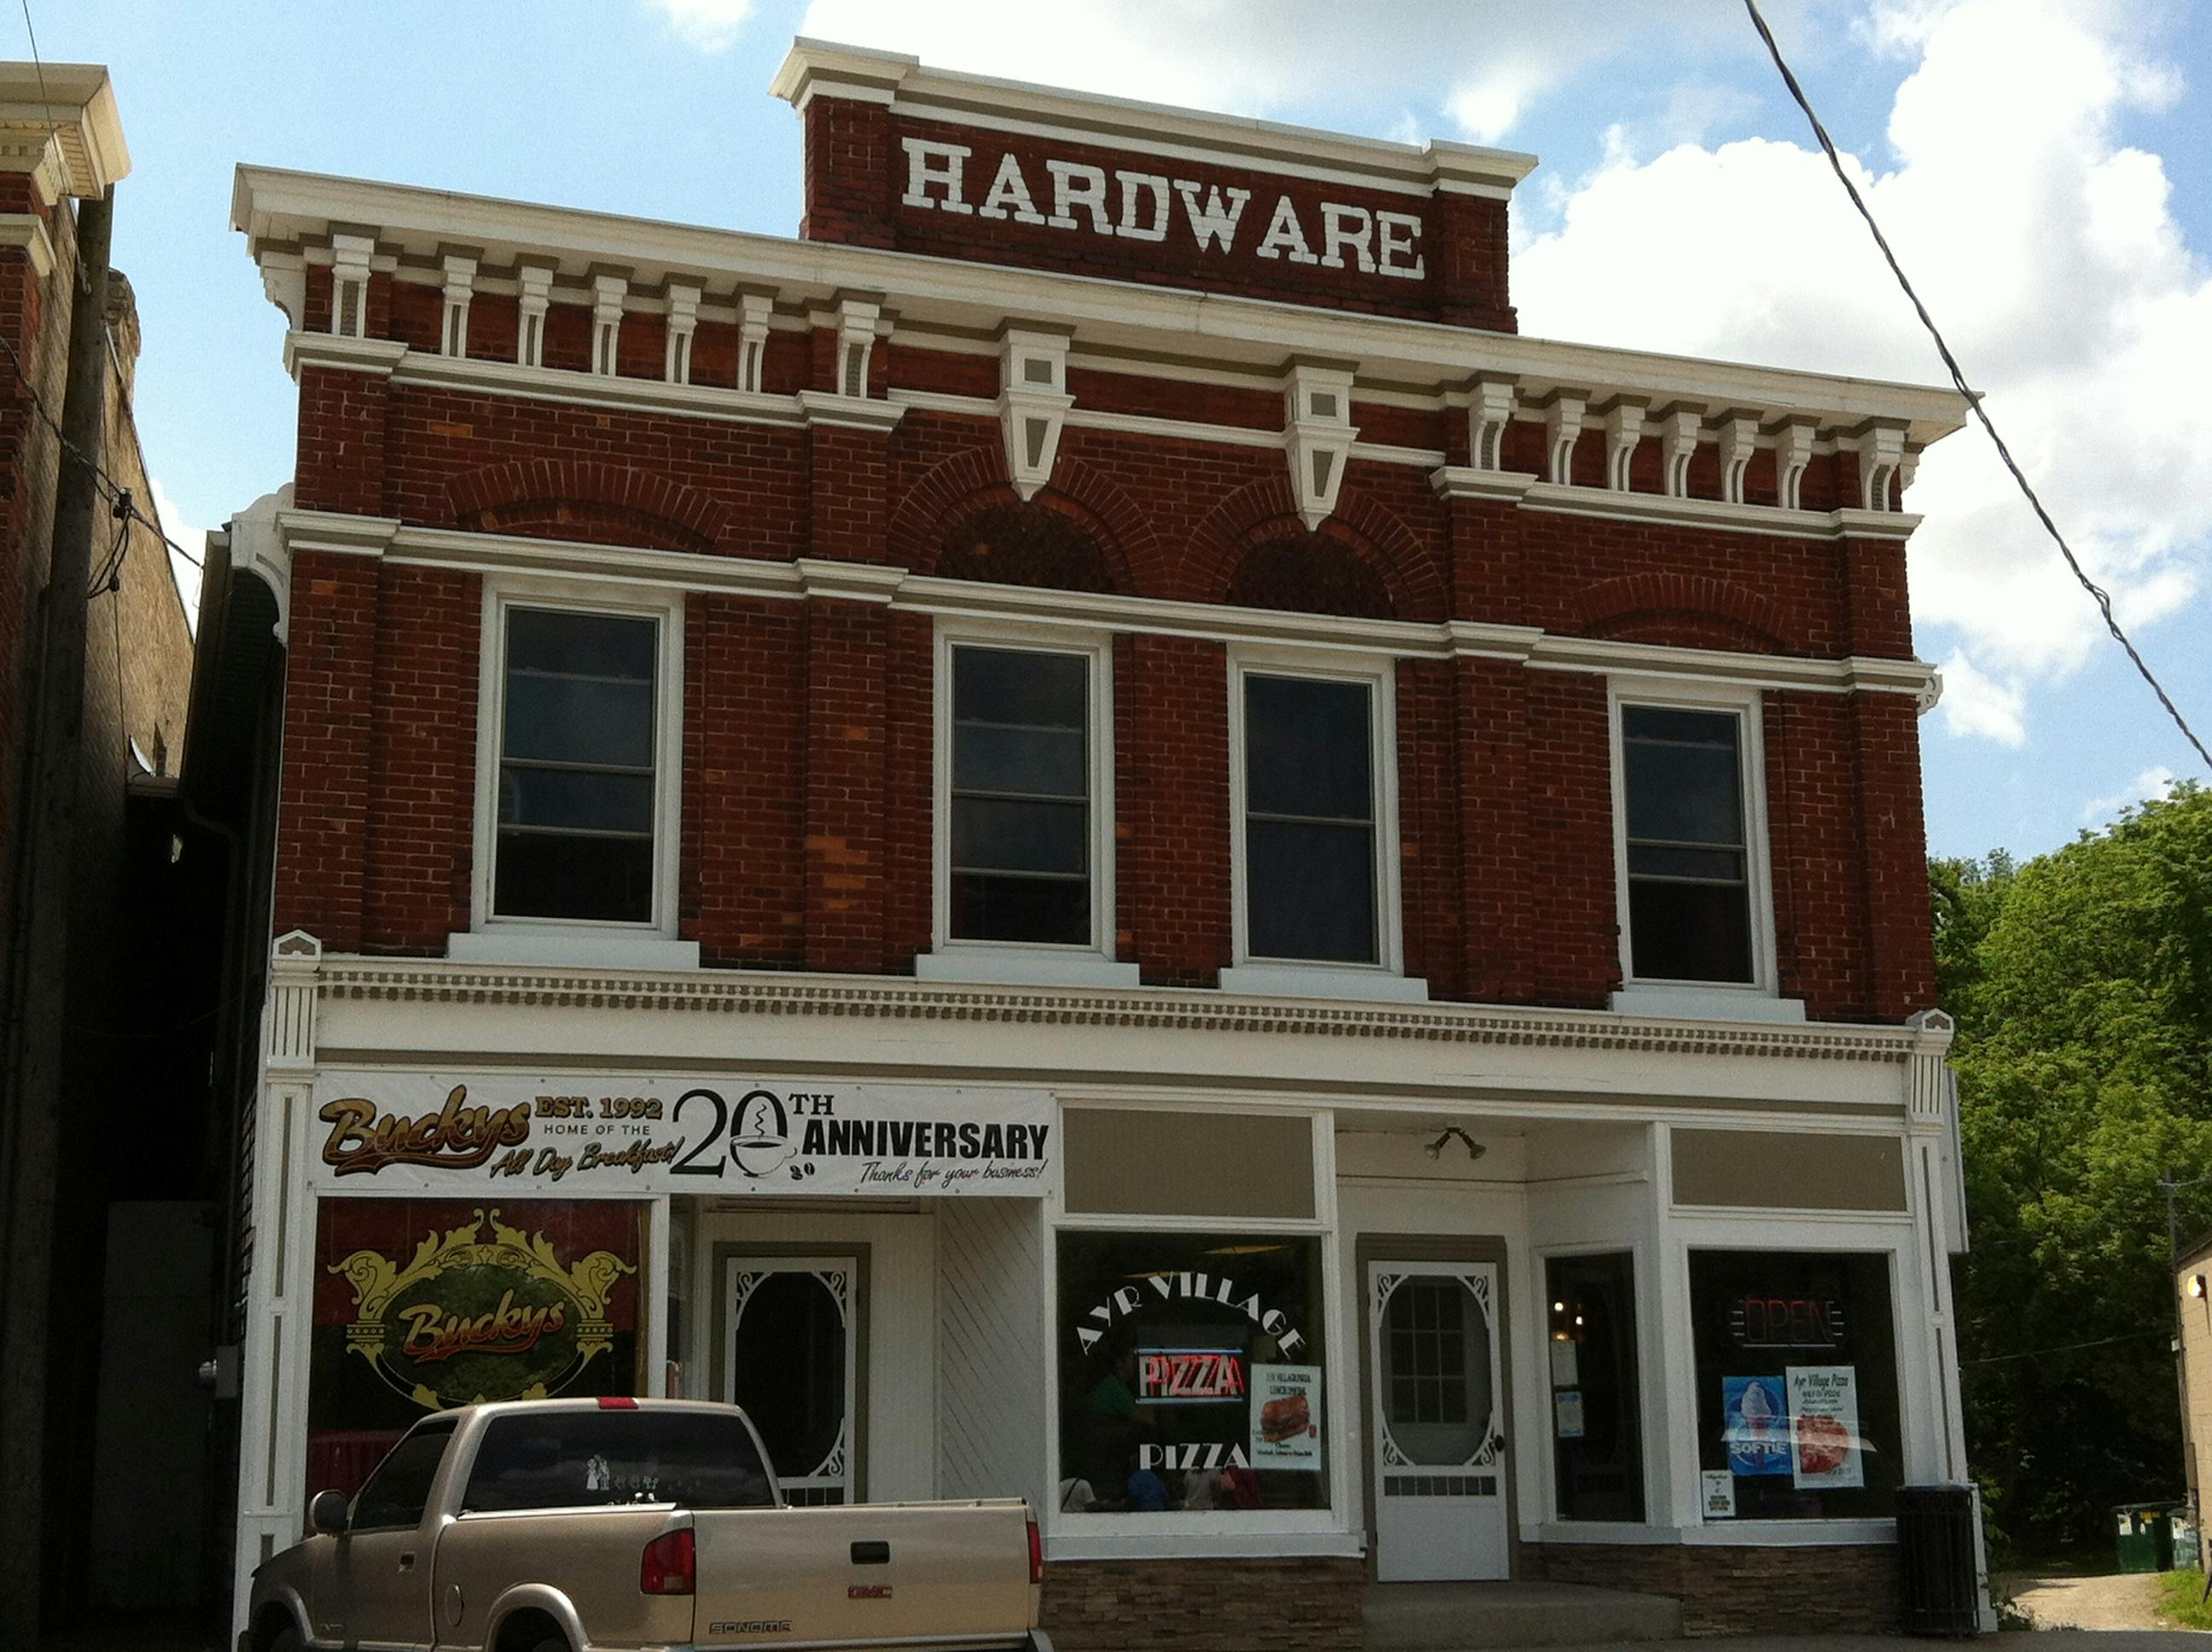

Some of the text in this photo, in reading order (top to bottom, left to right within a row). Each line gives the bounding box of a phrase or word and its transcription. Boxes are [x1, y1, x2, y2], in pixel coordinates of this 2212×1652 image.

[902, 137, 1425, 281] HARDWARE
[535, 1096, 662, 1120] EST. 1992
[544, 1124, 650, 1136] HOME OF THE
[319, 1084, 531, 1177] Buckys
[800, 1119, 1050, 1160] ANNIVERSARY
[490, 1136, 685, 1181] All Day Breakfast!
[860, 1159, 1049, 1189] Thanks for your business!
[399, 1288, 564, 1364] Buckys
[1076, 1271, 1307, 1359] AYR VILLAGE
[1743, 1297, 1835, 1344] OPEN
[1138, 1354, 1245, 1398] PIZZA
[1139, 1443, 1249, 1470] PIZZA
[709, 1620, 792, 1634] SONOMA
